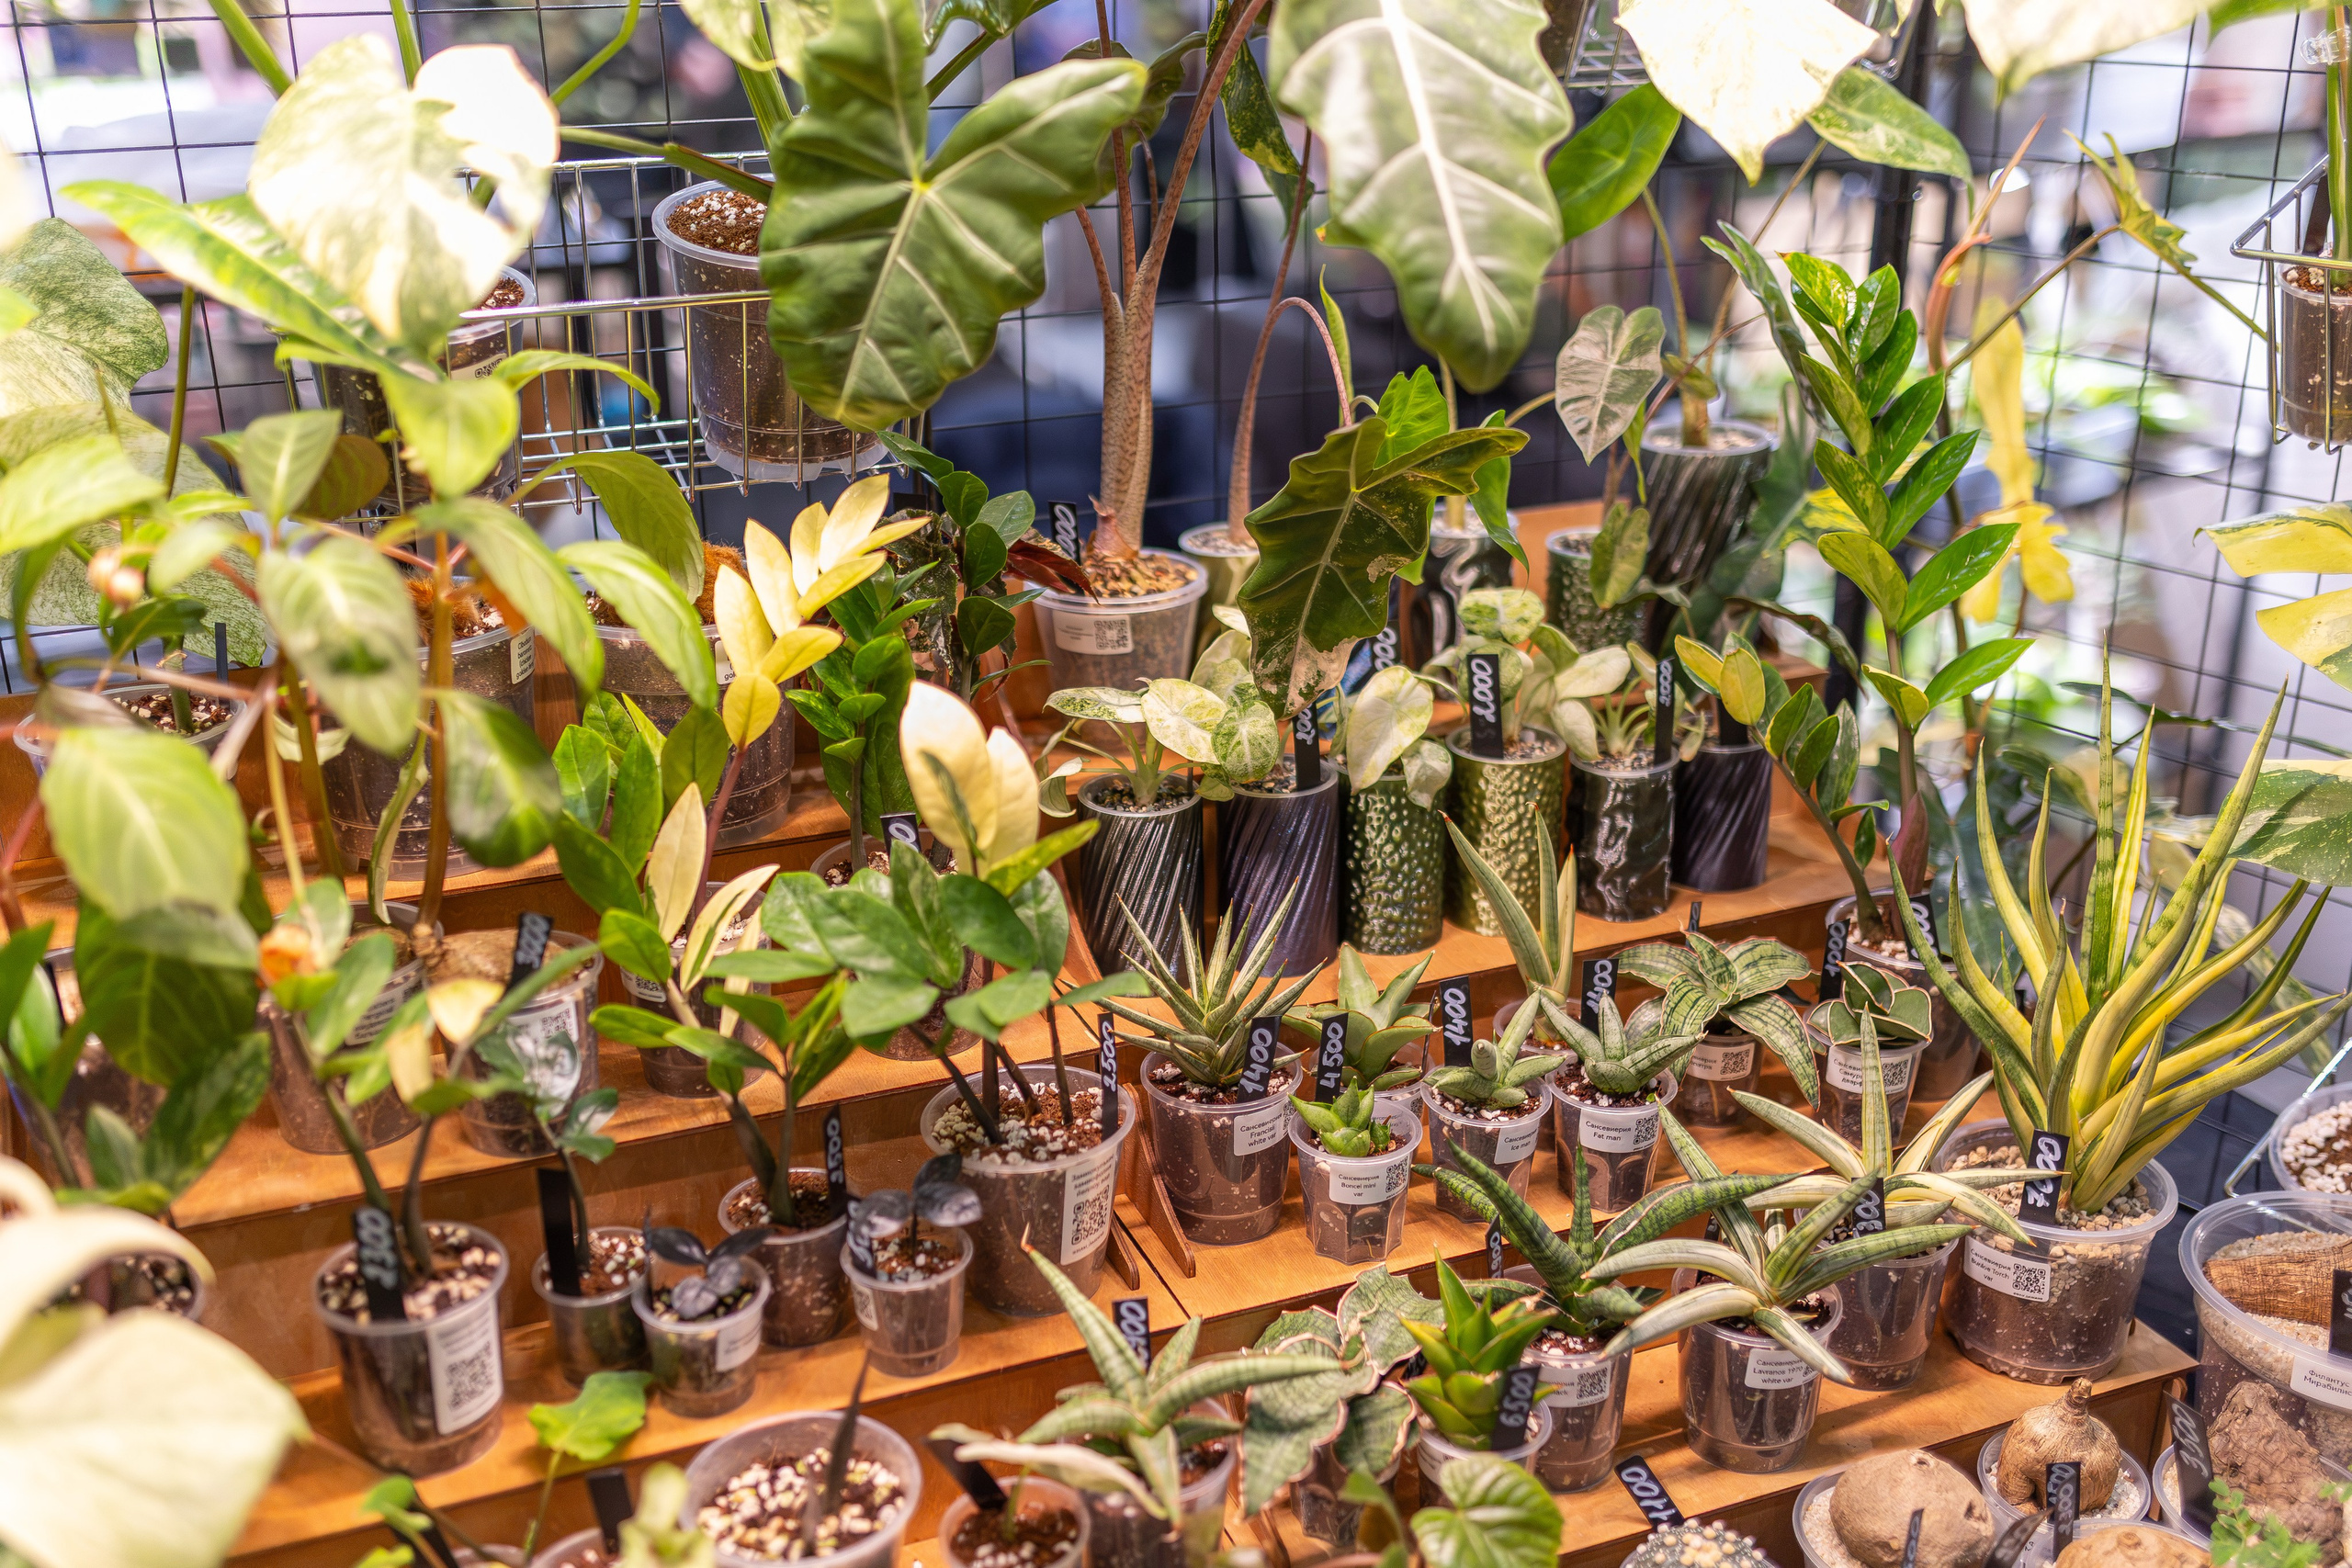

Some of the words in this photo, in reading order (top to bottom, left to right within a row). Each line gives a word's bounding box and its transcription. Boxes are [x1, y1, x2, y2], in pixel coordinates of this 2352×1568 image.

[1054, 504, 1076, 559] 000
[1373, 626, 1397, 671] 000
[1470, 658, 1496, 723] 2000
[1658, 660, 1672, 707] 2000
[1295, 703, 1316, 745] 200
[1824, 921, 1846, 977] 1000
[1586, 960, 1612, 1014] 1400
[1443, 987, 1470, 1046] 1400
[1102, 1021, 1117, 1092] 2500
[1240, 1028, 1272, 1094] 1400
[1319, 1021, 1344, 1089] 4500
[1833, 1058, 1862, 1072] Сансеви
[1240, 1112, 1283, 1132] Сансевиерия
[1248, 1137, 1267, 1147] white
[1268, 1133, 1276, 1141] var
[1585, 1121, 1632, 1134] Сансевиерия
[1593, 1132, 1604, 1140] Fat
[1338, 1174, 1380, 1182] Сансевиерия
[1971, 1248, 2011, 1270] Сансевиерия
[1753, 1367, 1786, 1376] Lavranos
[2303, 1375, 2352, 1396] Мирабилис
[2308, 1370, 2350, 1388] Филантус
[1499, 1371, 1535, 1427] 6500
[2171, 1403, 2209, 1478] 3500
[1621, 1466, 1676, 1521] 1100
